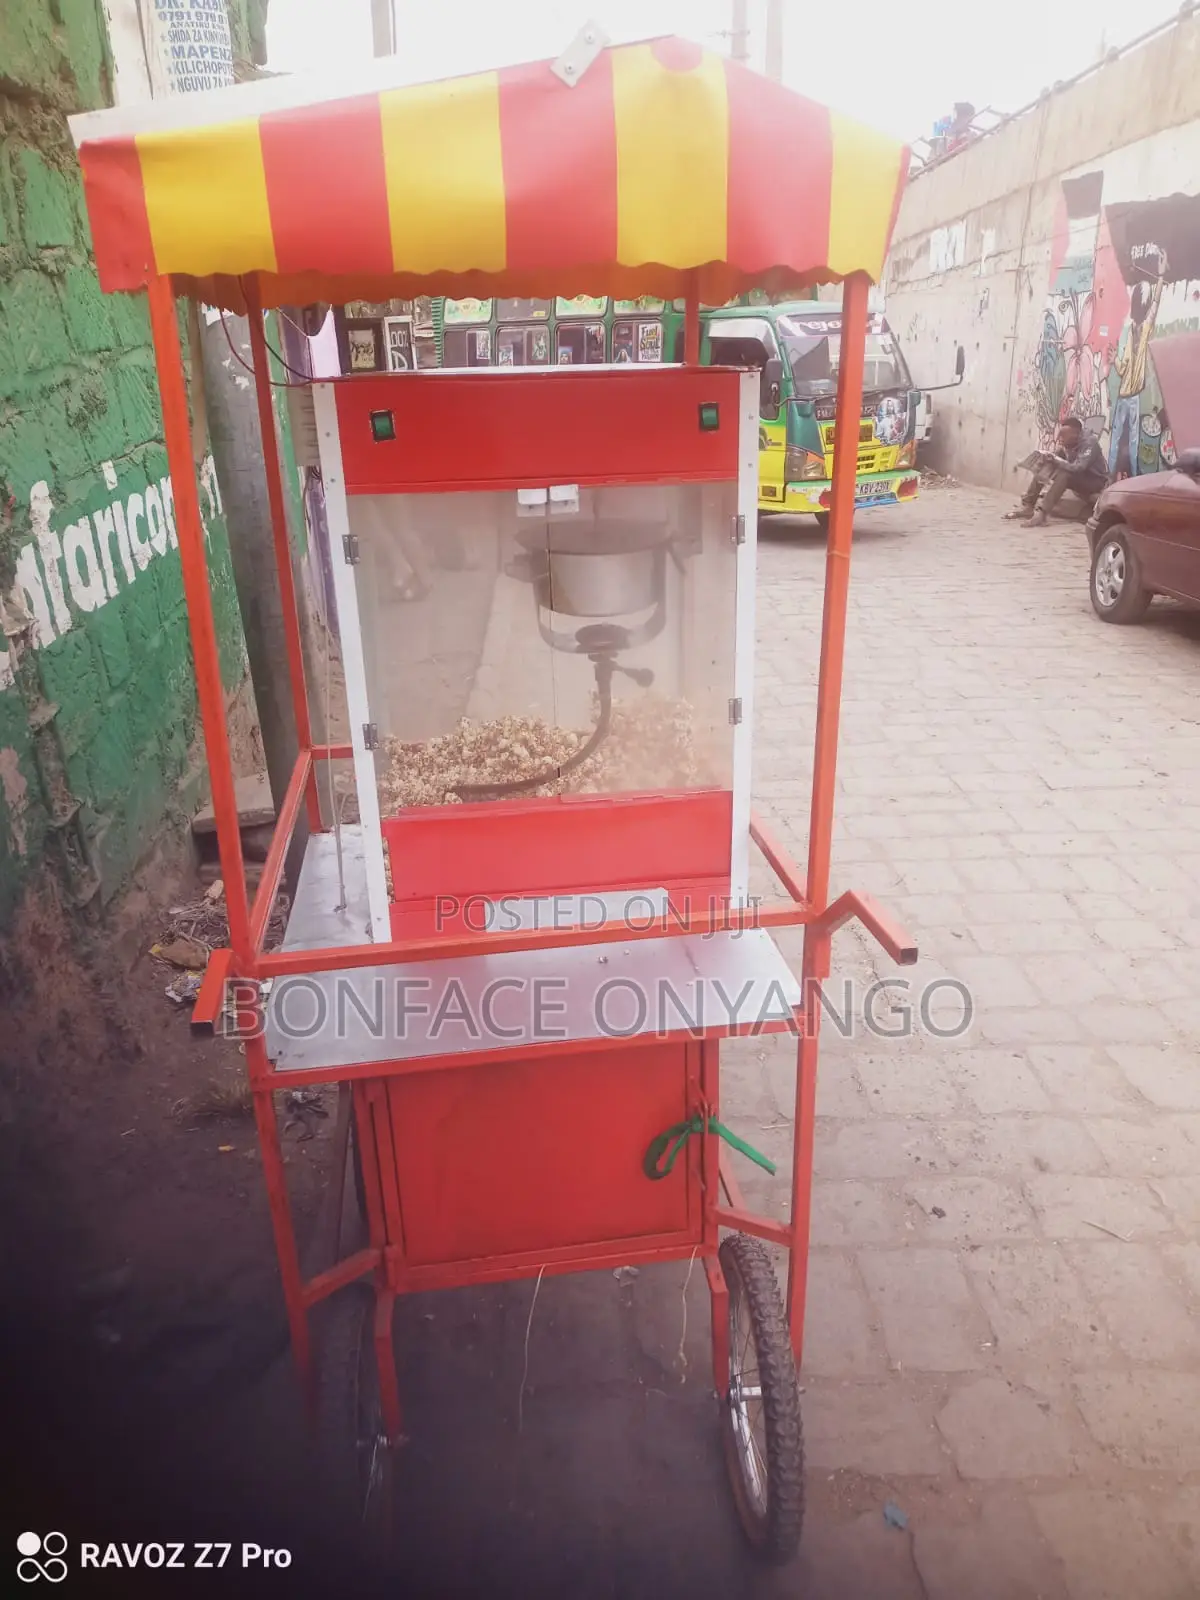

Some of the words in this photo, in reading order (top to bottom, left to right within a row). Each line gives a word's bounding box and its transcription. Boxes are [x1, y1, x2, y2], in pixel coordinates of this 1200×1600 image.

[158, 11, 192, 21] 0791
[168, 29, 191, 42] SHIDA
[192, 29, 204, 42] ZA
[177, 75, 211, 93] NGUVU
